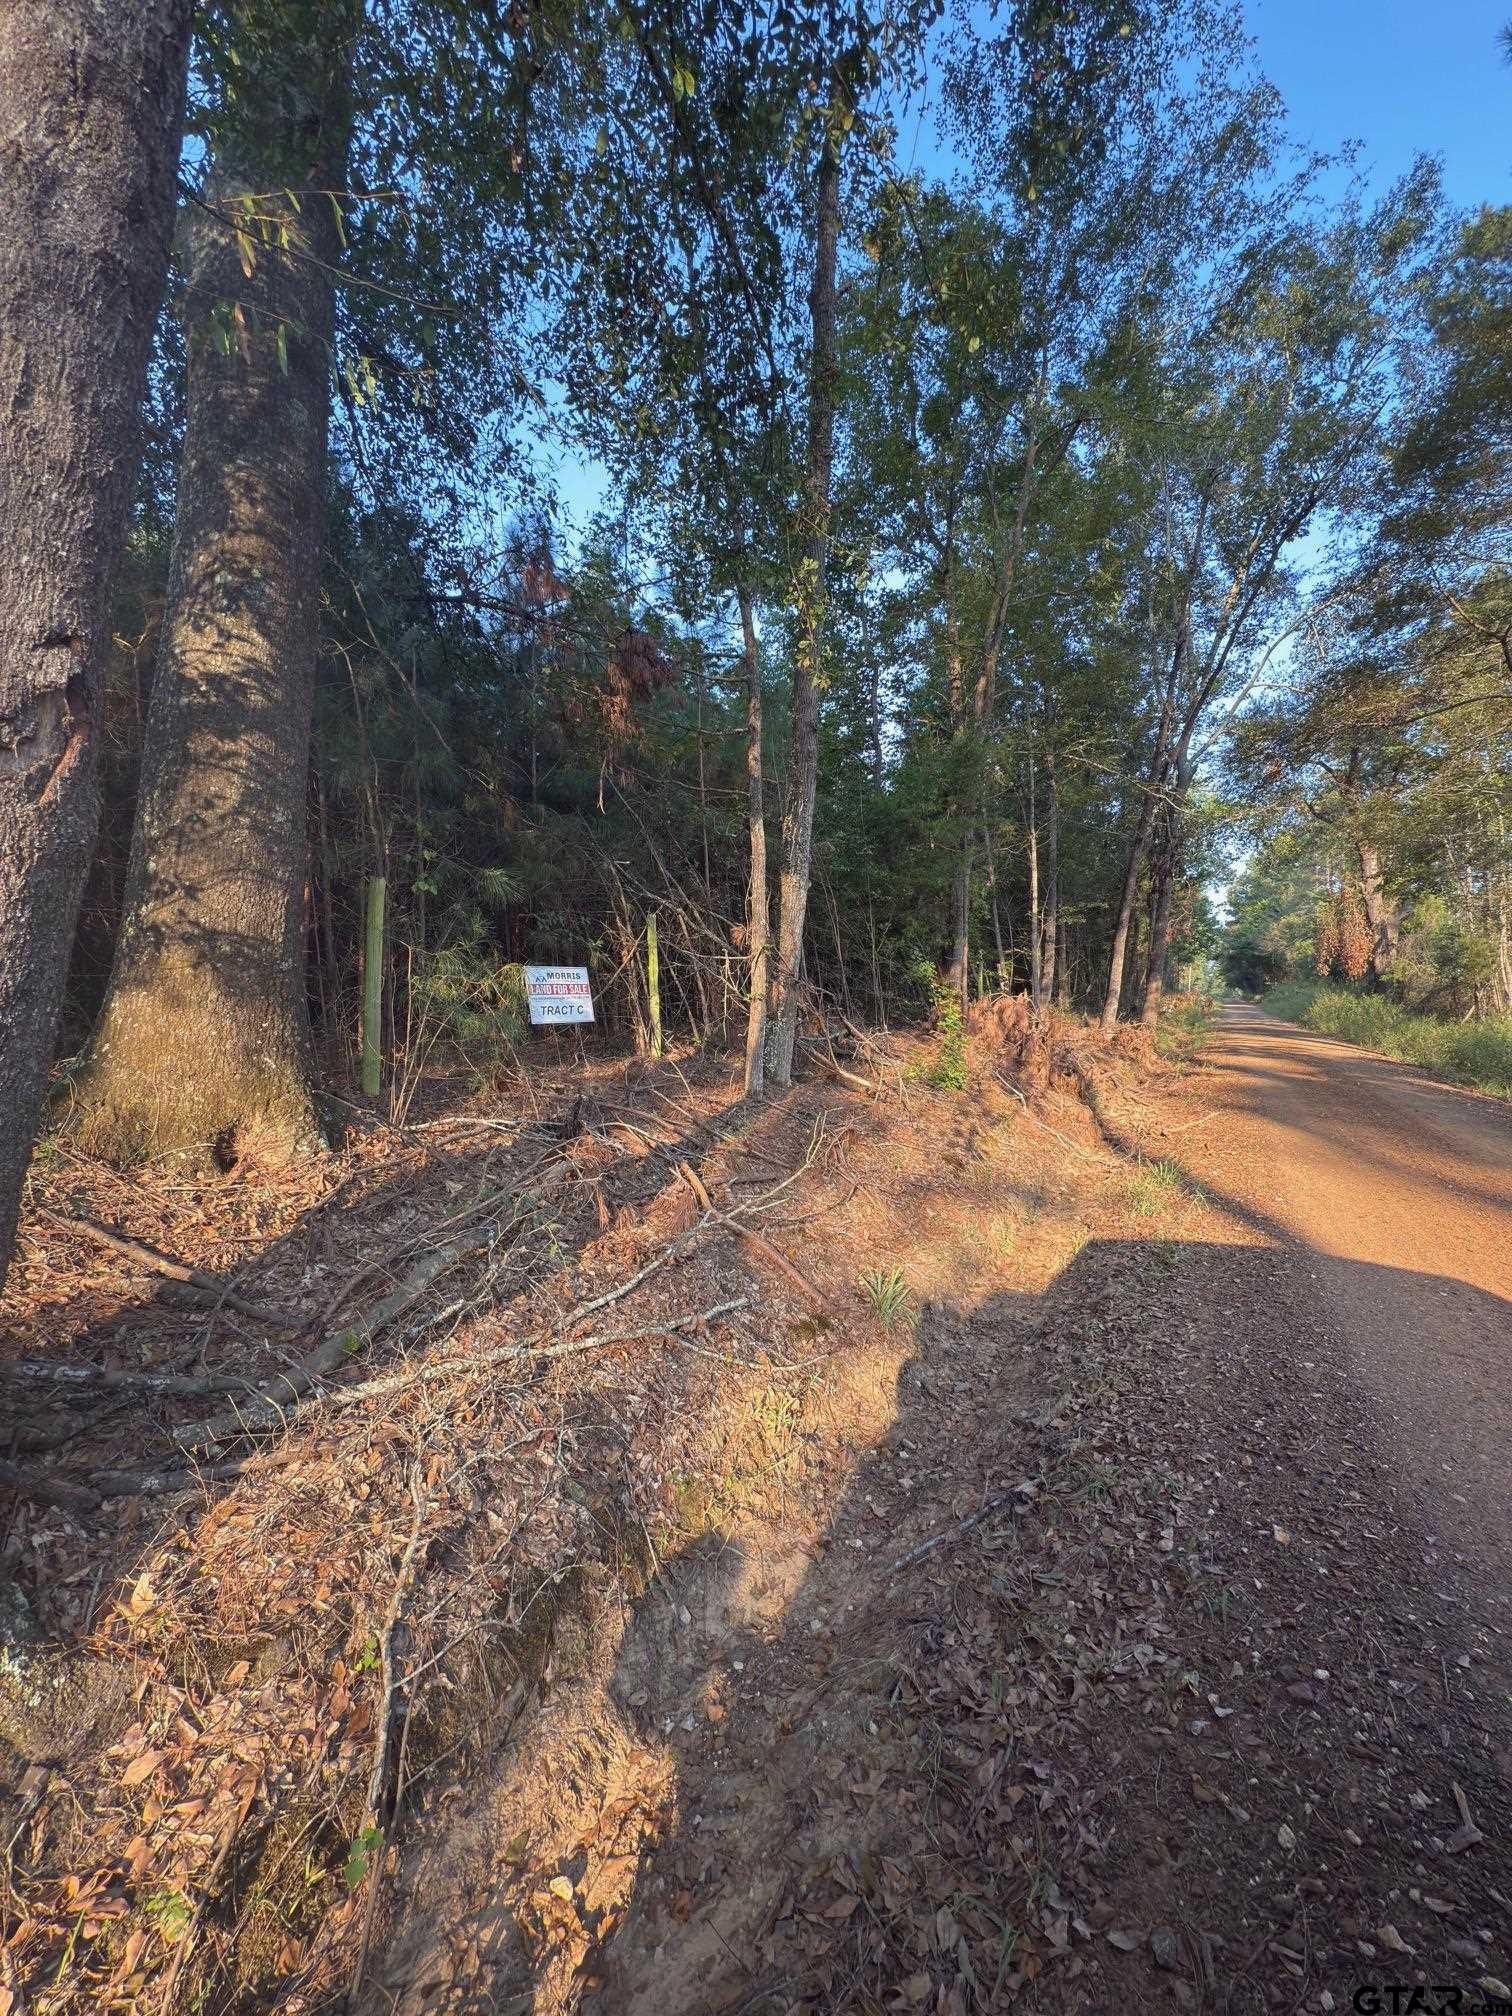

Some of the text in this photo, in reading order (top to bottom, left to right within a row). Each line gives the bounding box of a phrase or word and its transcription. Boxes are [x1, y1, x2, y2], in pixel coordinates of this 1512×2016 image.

[546, 972, 581, 980] MORRIS
[529, 984, 588, 995] LAND FOR SALE
[541, 1005, 584, 1015] TRACT C
